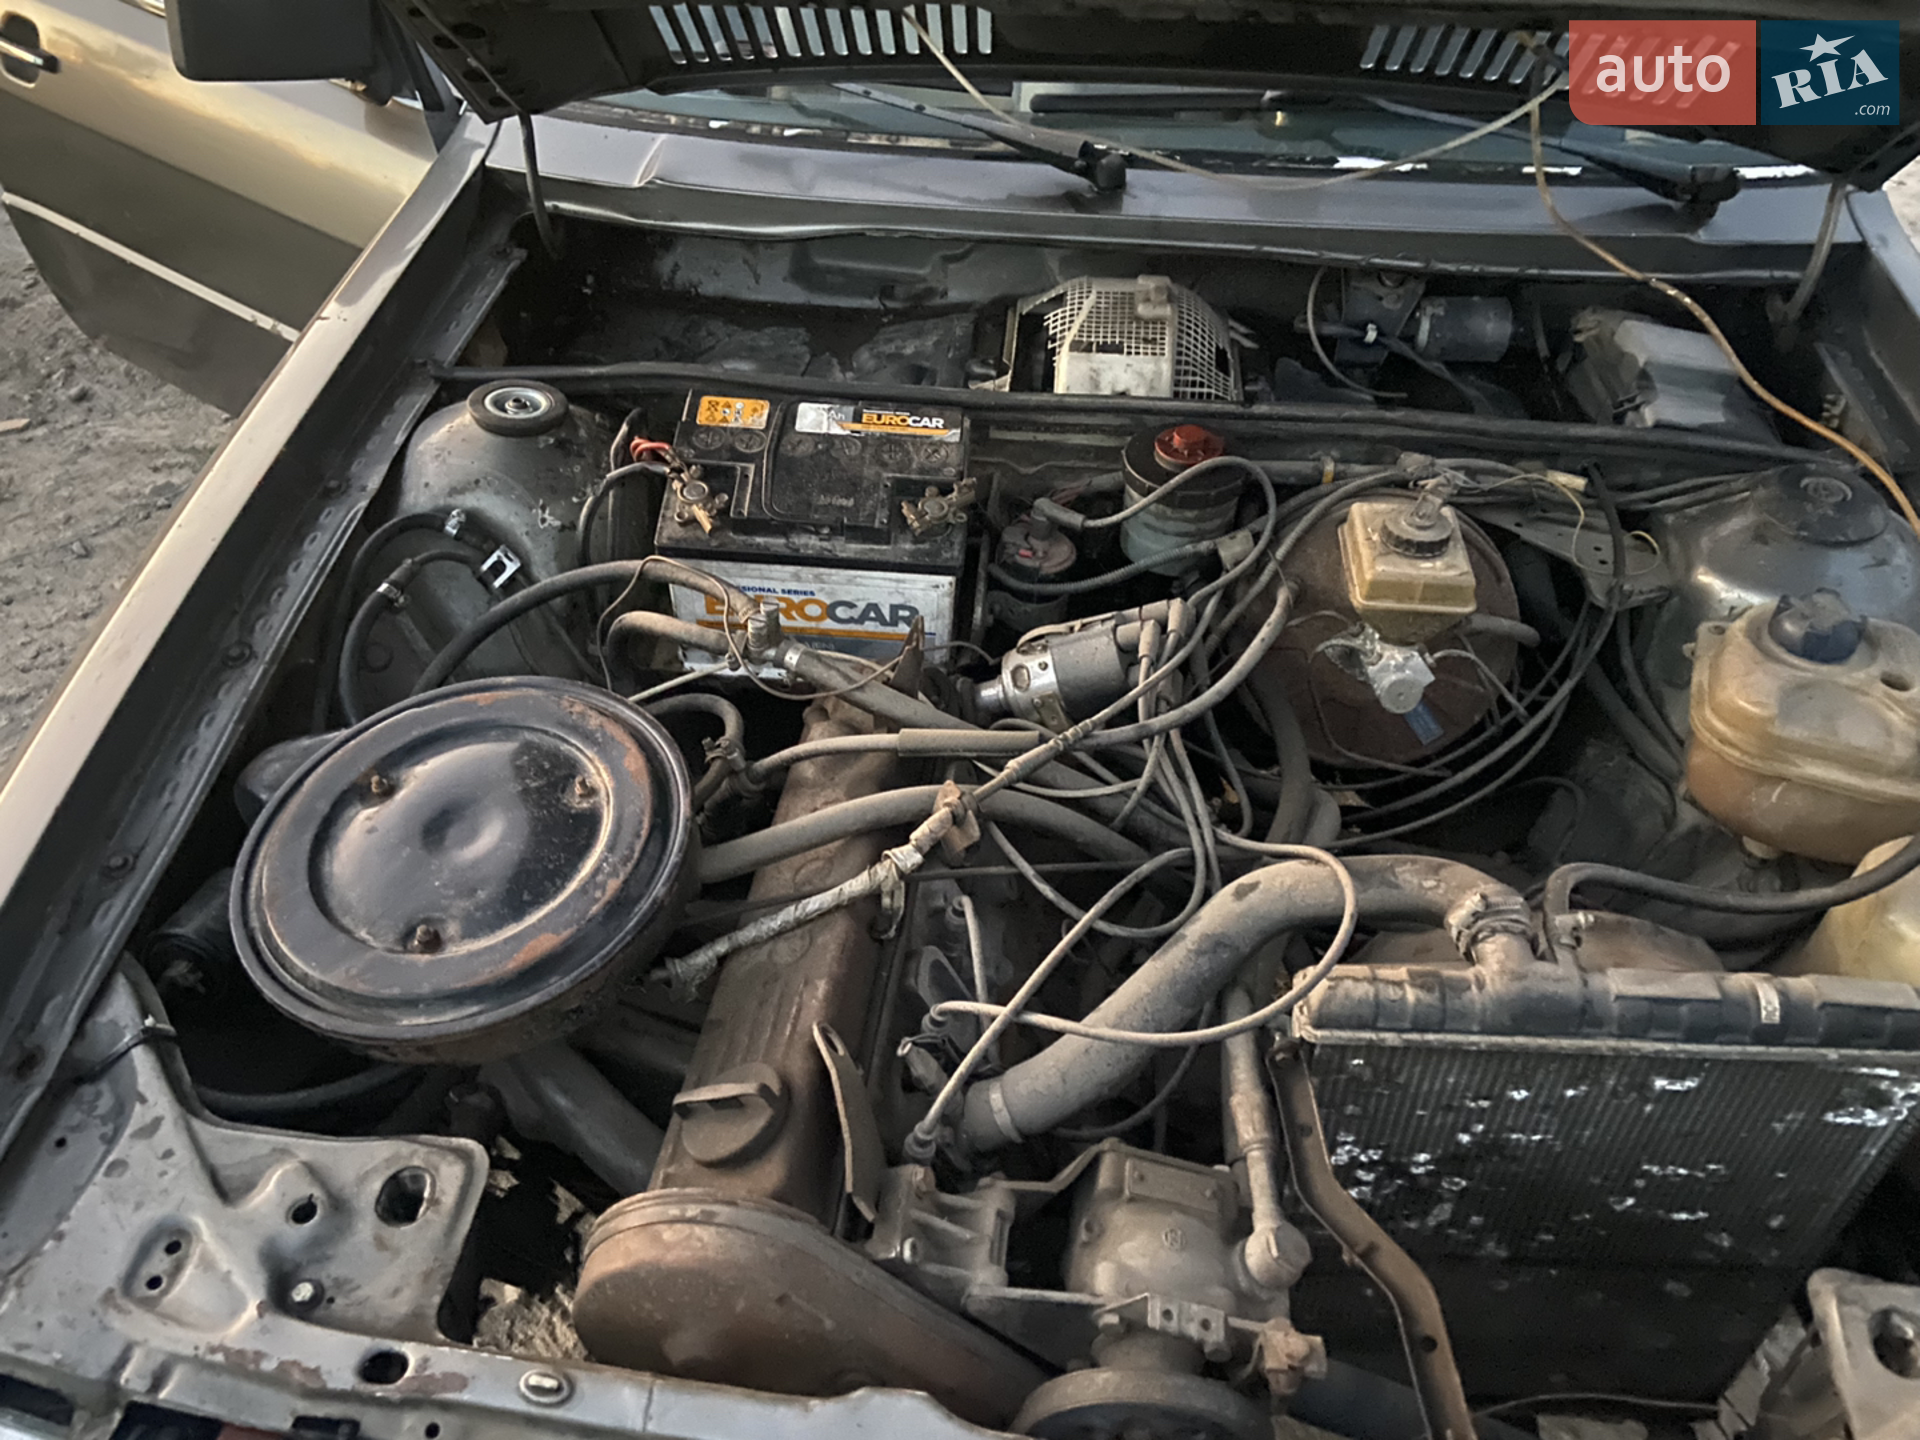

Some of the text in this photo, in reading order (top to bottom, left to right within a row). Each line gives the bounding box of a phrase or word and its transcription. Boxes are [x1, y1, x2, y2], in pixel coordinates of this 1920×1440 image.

[862, 412, 945, 429] EUROCAR
[740, 585, 816, 597] SIONAL SERIES
[705, 594, 920, 628] EROCAR
